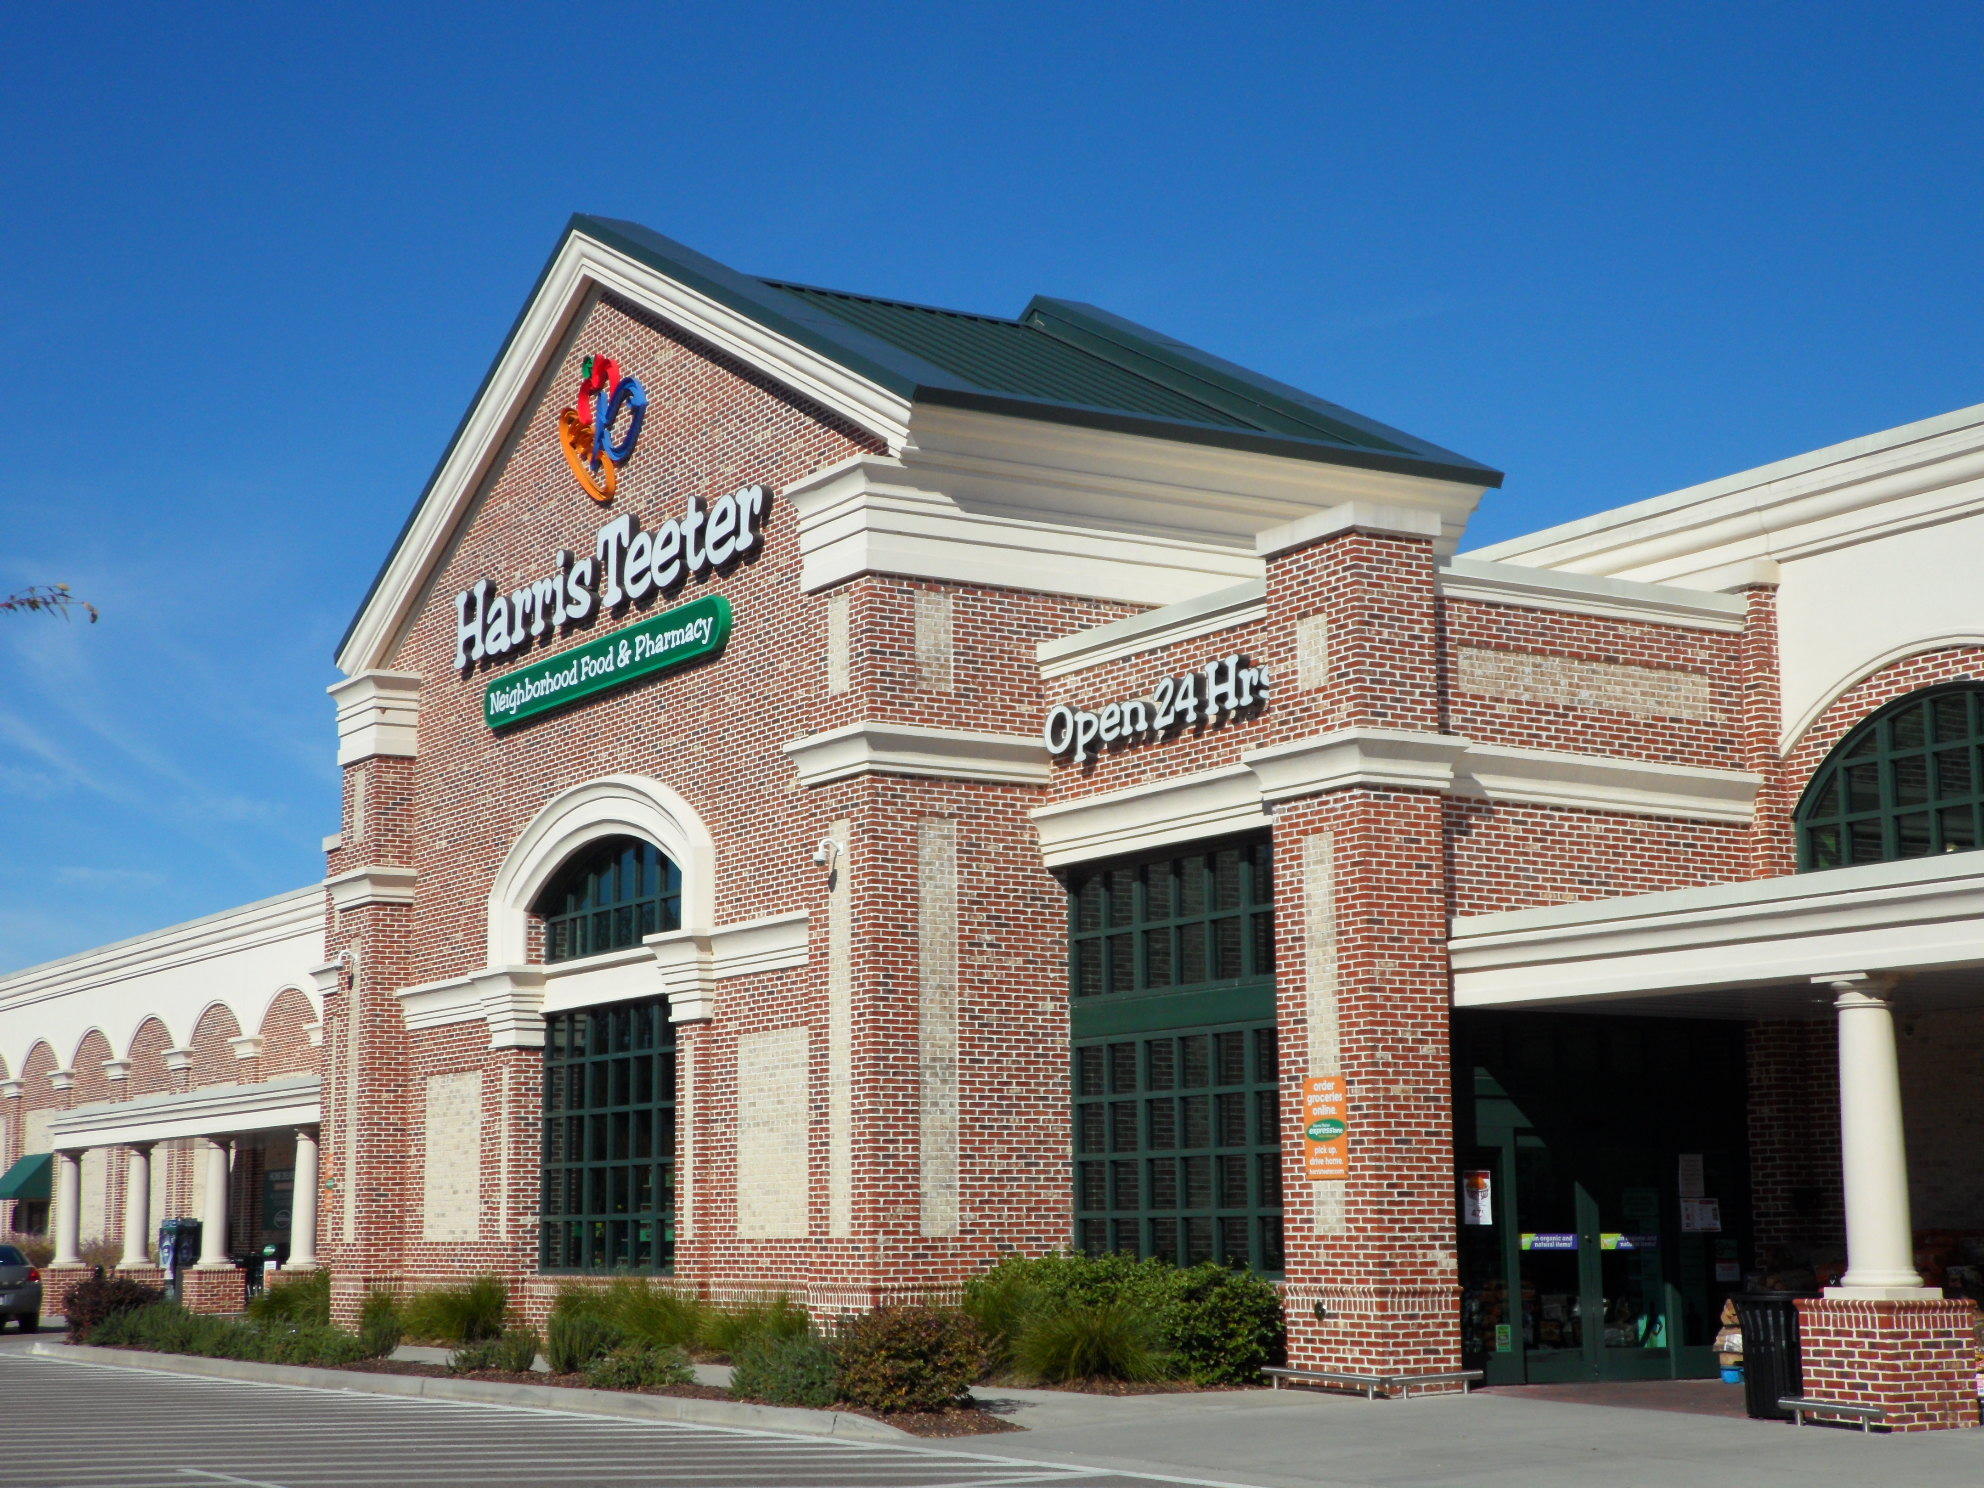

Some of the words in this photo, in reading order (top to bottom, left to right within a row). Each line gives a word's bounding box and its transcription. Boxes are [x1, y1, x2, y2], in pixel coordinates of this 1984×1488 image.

[454, 549, 592, 669] Harris
[596, 484, 763, 608] Teeter
[489, 659, 578, 715] Neighborhood
[581, 646, 614, 682] Food
[617, 639, 631, 670] &
[634, 616, 713, 662] Pharmacy
[1044, 700, 1148, 762] Open
[1153, 672, 1199, 730] 24
[1307, 1092, 1343, 1106] groceries
[1313, 1080, 1335, 1091] order
